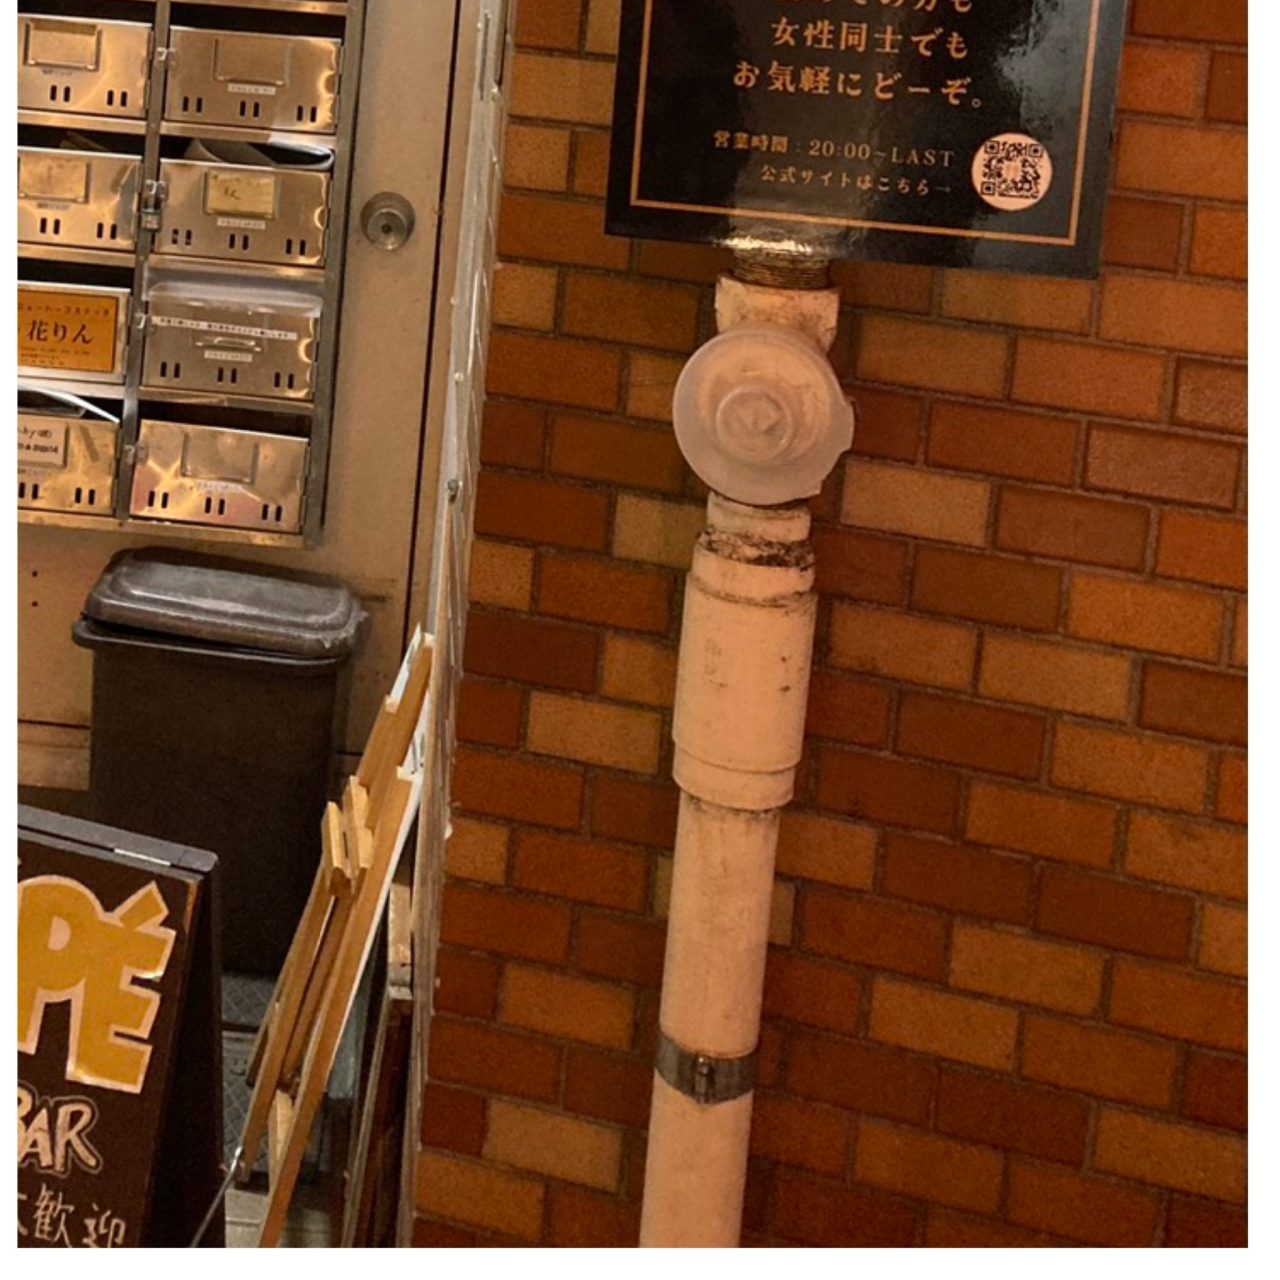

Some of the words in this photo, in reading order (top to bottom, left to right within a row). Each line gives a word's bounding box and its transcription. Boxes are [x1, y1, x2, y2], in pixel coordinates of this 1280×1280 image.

[771, 17, 969, 59] 女性同士でも
[733, 61, 982, 109] お気軽にどーぞ。
[27, 319, 94, 345] 花りん
